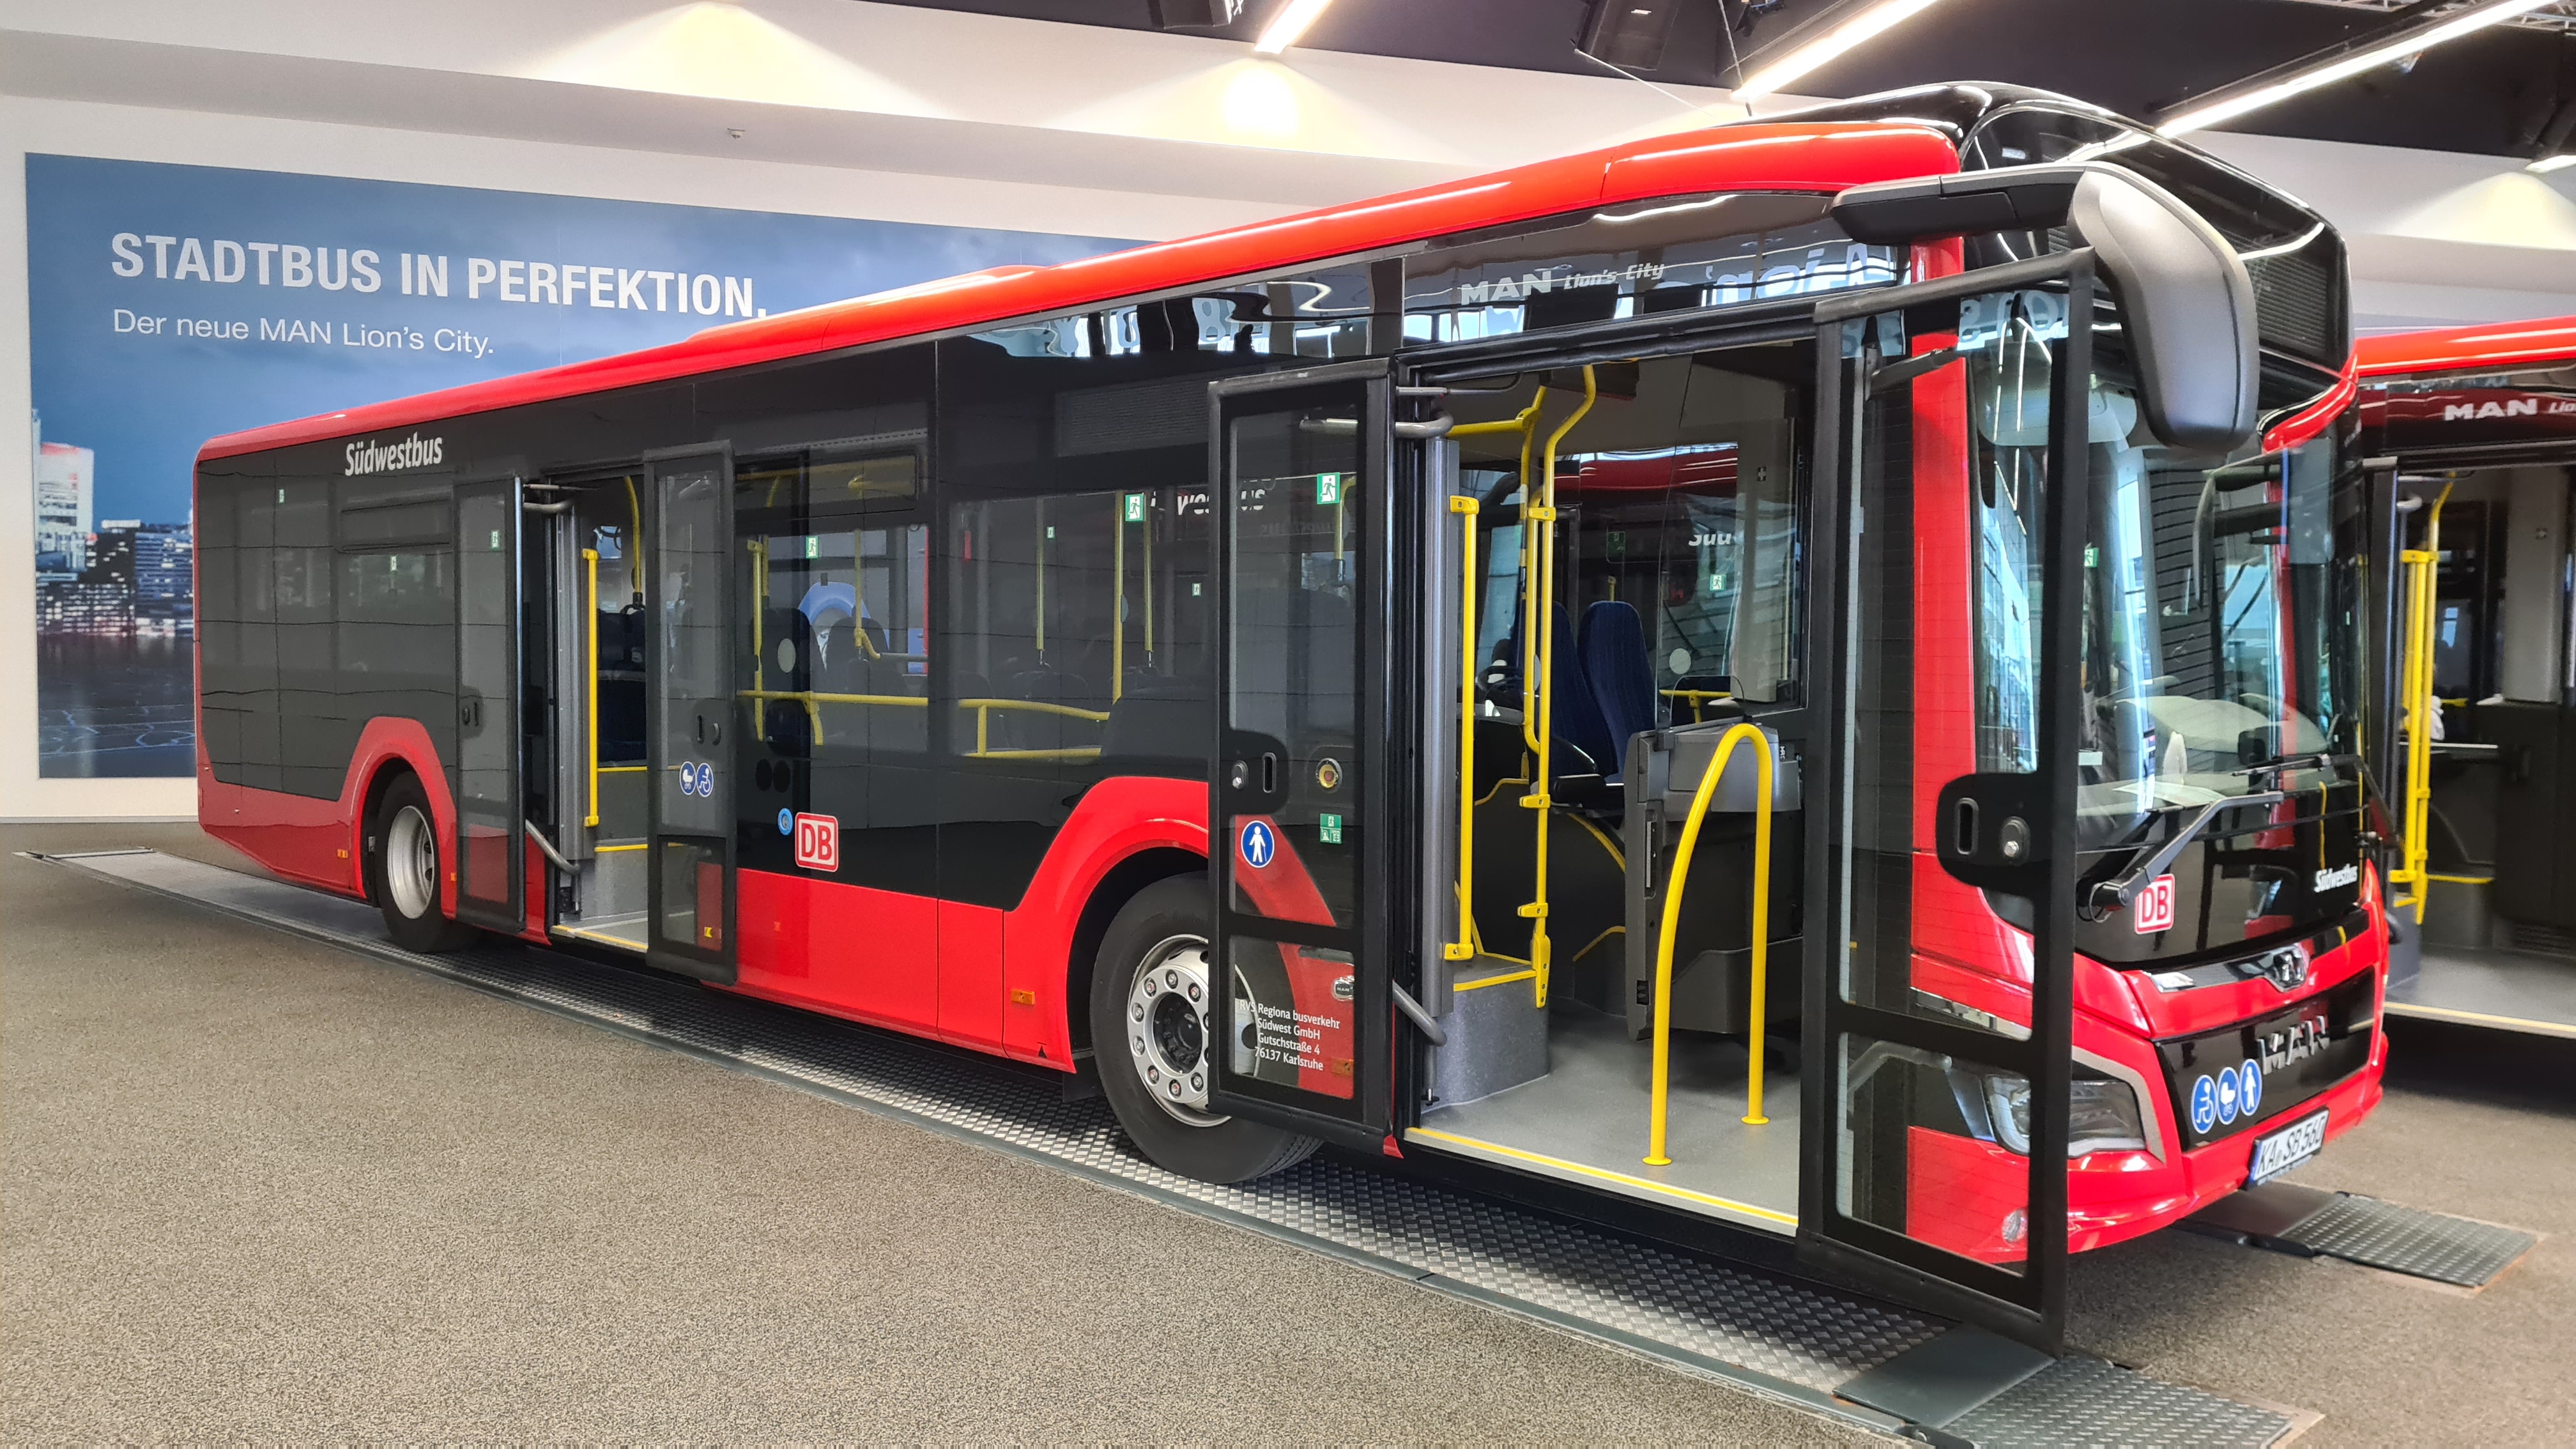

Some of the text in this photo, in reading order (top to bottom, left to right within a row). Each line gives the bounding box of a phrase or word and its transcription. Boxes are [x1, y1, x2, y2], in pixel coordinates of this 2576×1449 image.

[111, 232, 767, 318] STADTBUS IN PERFEKTION.
[1460, 262, 1665, 306] MAN Lion's City
[113, 309, 494, 359] Der neue MAN Lion's City.
[2444, 398, 2538, 421] MAN
[344, 431, 443, 477] Südwestbus
[801, 822, 833, 862] DB
[2140, 884, 2170, 925] DB
[1239, 999, 1256, 1013] RVS
[1257, 1017, 1321, 1040] Südwest GmbH
[1257, 1032, 1321, 1055] Gutschstraße 4
[2256, 1015, 2331, 1075] MAN
[1254, 1046, 1324, 1071] 76137 Karlsruhe
[2257, 1139, 2278, 1174] KA
